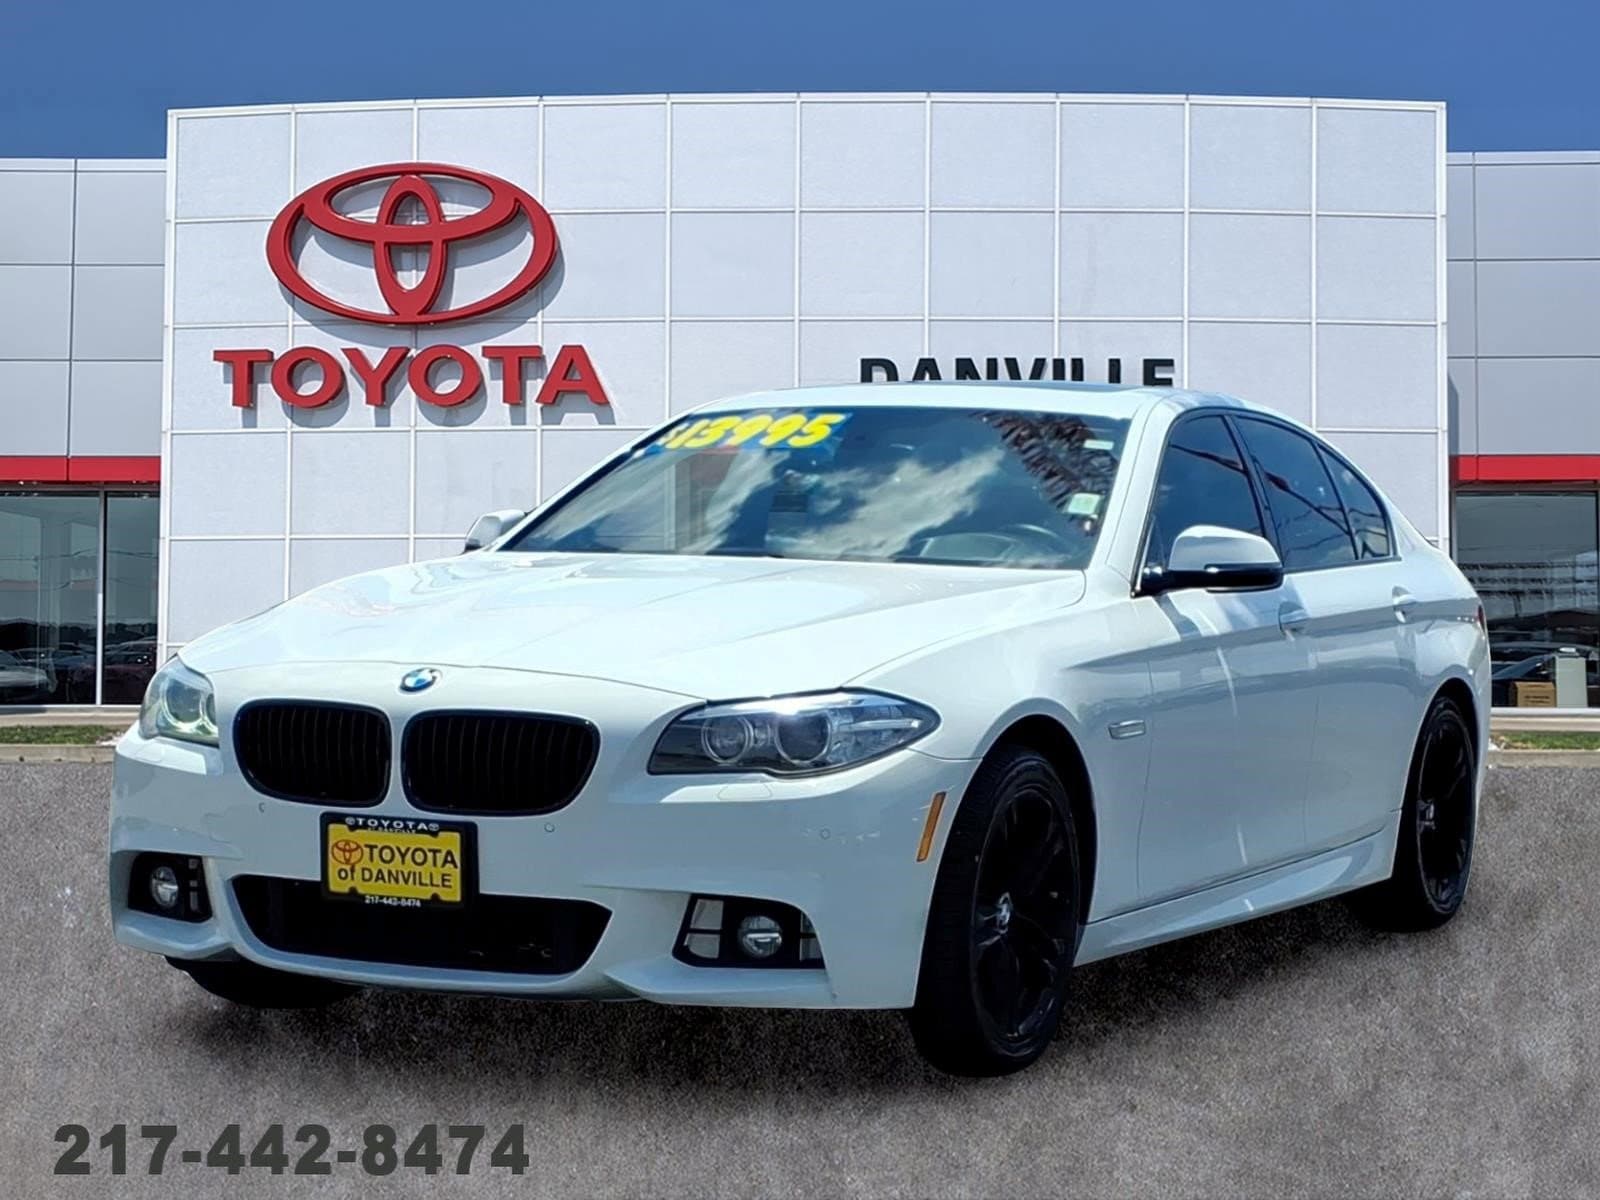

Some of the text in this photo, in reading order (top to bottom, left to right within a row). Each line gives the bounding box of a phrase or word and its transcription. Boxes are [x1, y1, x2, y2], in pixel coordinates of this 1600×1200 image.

[214, 344, 611, 408] TOYOTA
[356, 817, 428, 831] TOYOTA
[364, 844, 458, 869] TOYOTA
[361, 867, 452, 889] DANVILLE
